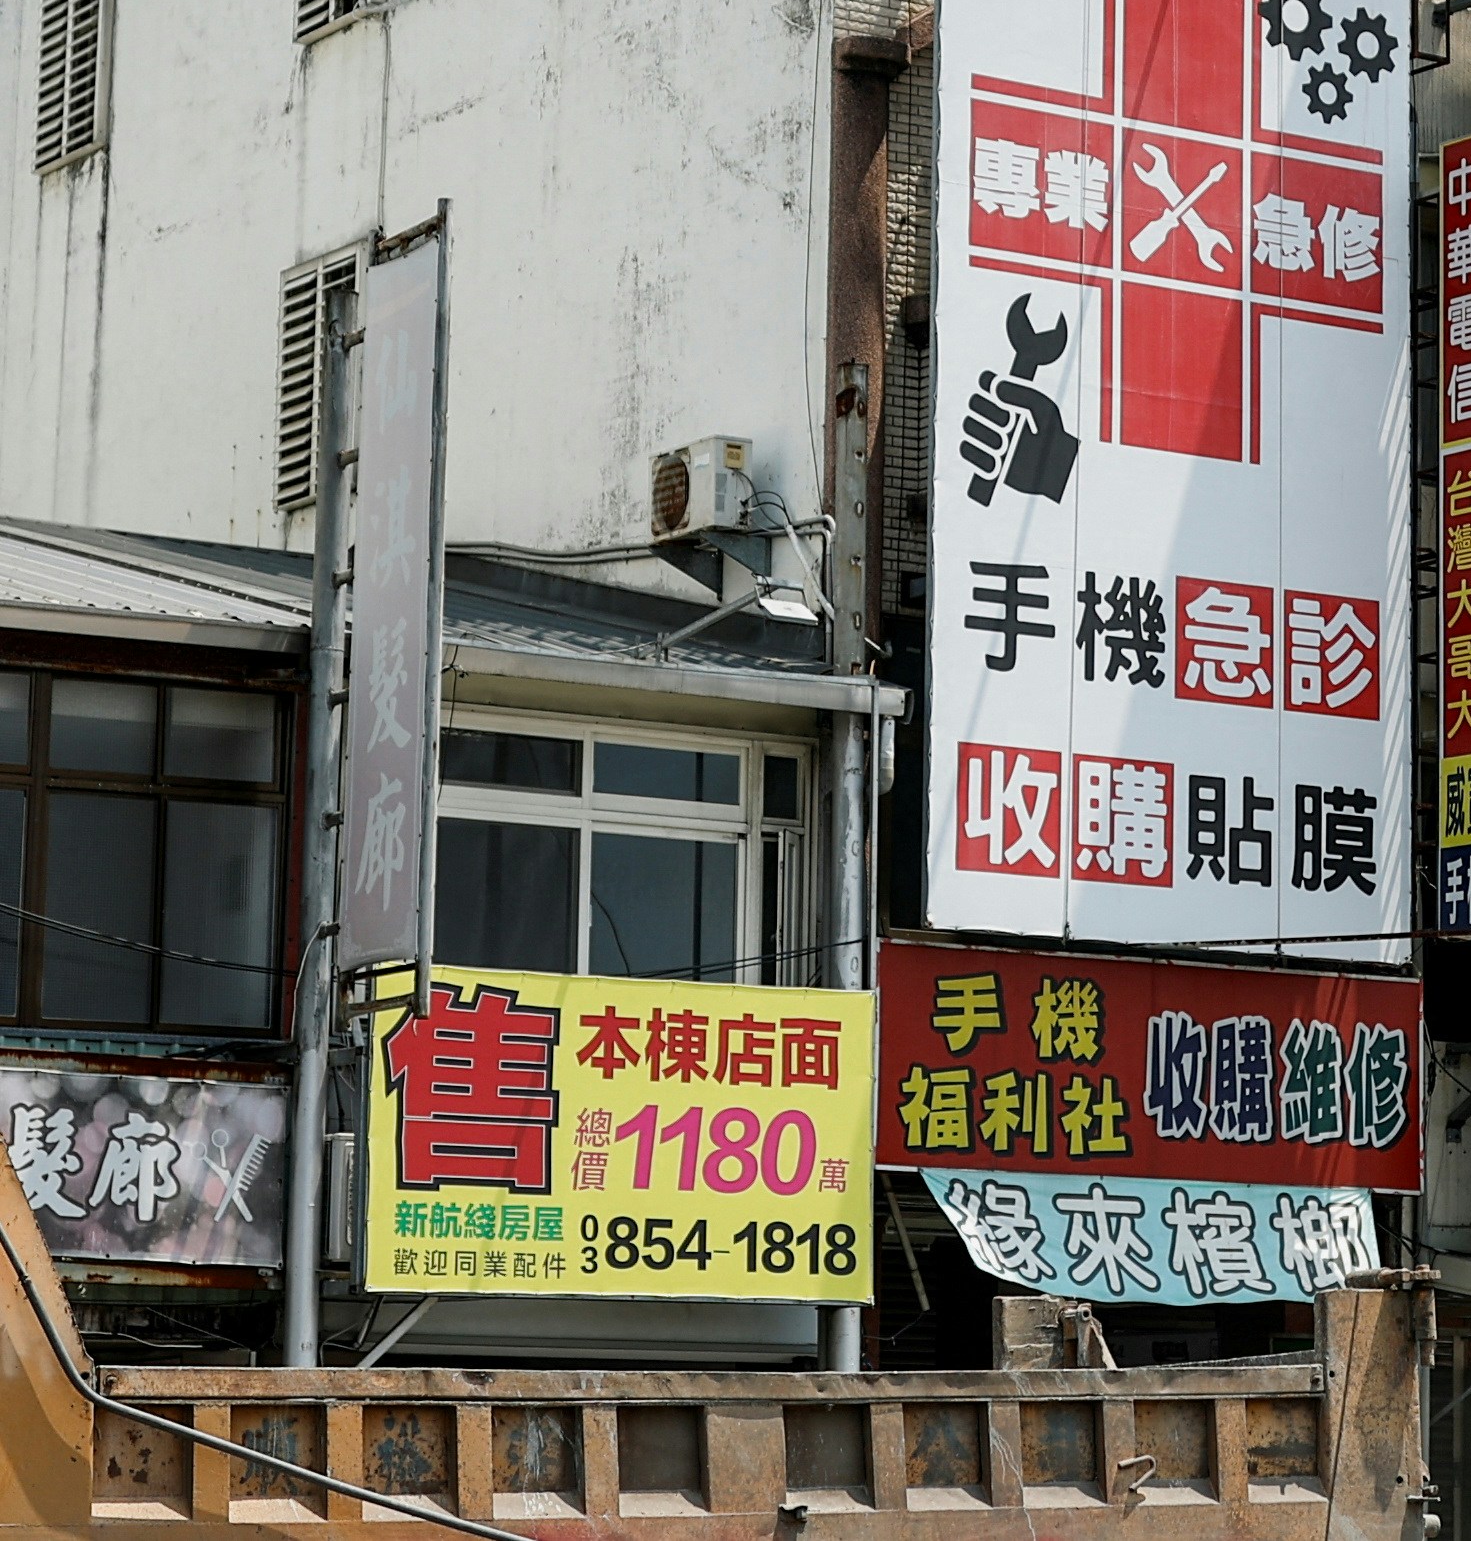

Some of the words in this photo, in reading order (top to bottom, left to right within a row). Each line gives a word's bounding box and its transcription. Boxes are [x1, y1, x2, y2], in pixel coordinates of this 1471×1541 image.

[973, 137, 1110, 232] 專業
[1253, 192, 1382, 283] 急修
[964, 560, 1378, 710] 手機急診
[963, 750, 1378, 897] 收購貼膜
[575, 1005, 842, 1090] 本棟店面
[932, 974, 1102, 1060] 手機
[382, 982, 561, 1194] 售
[900, 1065, 1128, 1156] 福利社
[1145, 1010, 1409, 1148] 收購維修
[8, 1104, 181, 1222] 髮廊
[571, 1107, 612, 1191] 總價
[614, 1104, 817, 1196] 1180
[818, 1158, 850, 1193] 萬
[394, 1248, 567, 1279] 歡迎同業配件
[605, 1215, 857, 1276] 854-1818
